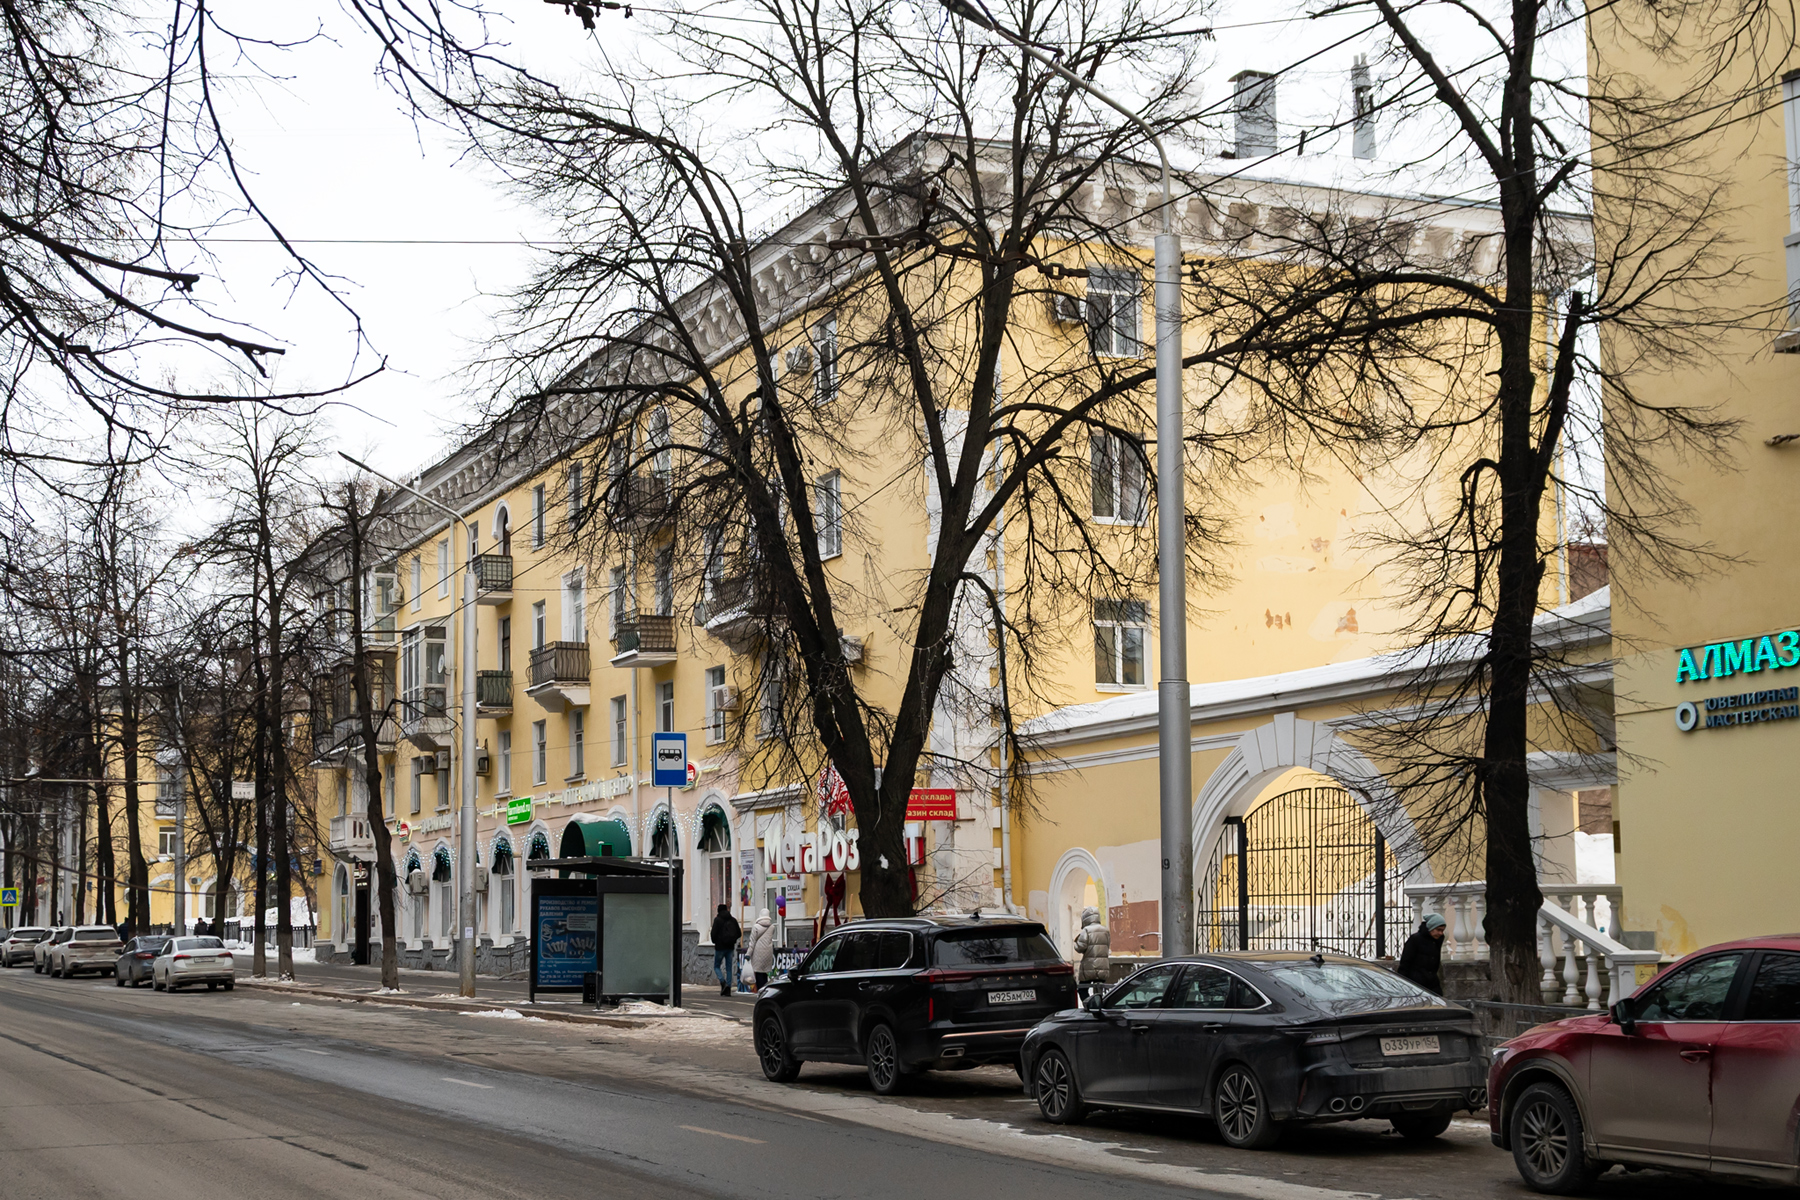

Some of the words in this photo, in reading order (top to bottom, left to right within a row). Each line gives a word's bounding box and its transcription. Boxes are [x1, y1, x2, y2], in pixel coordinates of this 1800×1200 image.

[1675, 631, 1800, 683] АЛМАЗ
[1704, 686, 1799, 711] ЮВЕЛИРНАЯ
[1705, 705, 1799, 728] МАСТЕРСКАЯ
